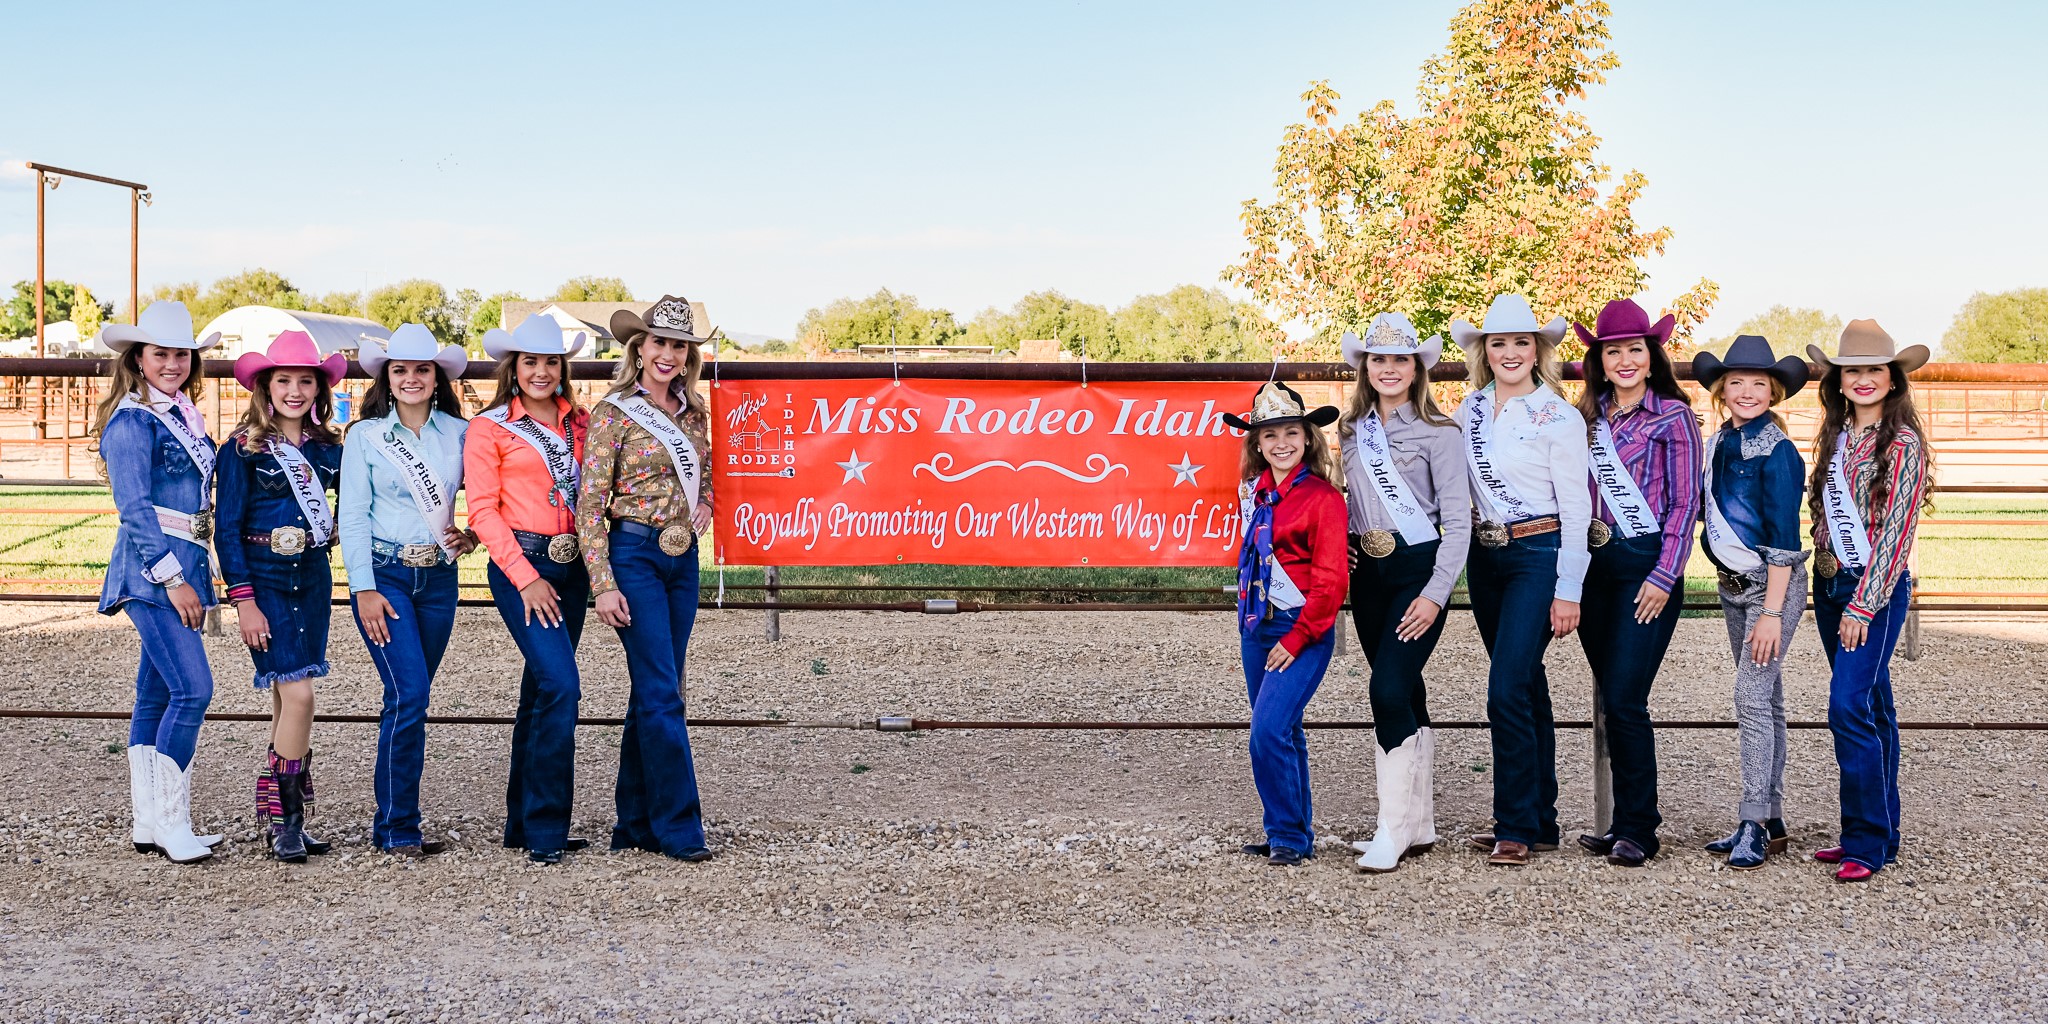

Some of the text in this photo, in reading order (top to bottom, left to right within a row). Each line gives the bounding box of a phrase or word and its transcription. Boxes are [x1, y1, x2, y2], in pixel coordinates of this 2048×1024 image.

[726, 393, 768, 430] Miss
[802, 396, 1251, 438] Miss Rodeo Idaho
[629, 404, 694, 481] Miss Rodeo Idaho
[727, 454, 796, 466] RODEO
[1362, 435, 1383, 455] Rodeo
[1470, 417, 1487, 462] Preston
[385, 445, 434, 513] Construction Consulting
[392, 438, 442, 507] Tom Pitcher
[1369, 458, 1400, 503] Idaho
[1476, 459, 1502, 495] Night
[1396, 502, 1416, 517] 2019
[1597, 459, 1631, 502] Night
[1619, 502, 1650, 537] Rode
[734, 497, 1244, 551] Royally Promoting Our Western Way of Lif
[1837, 520, 1863, 569] Commerc
